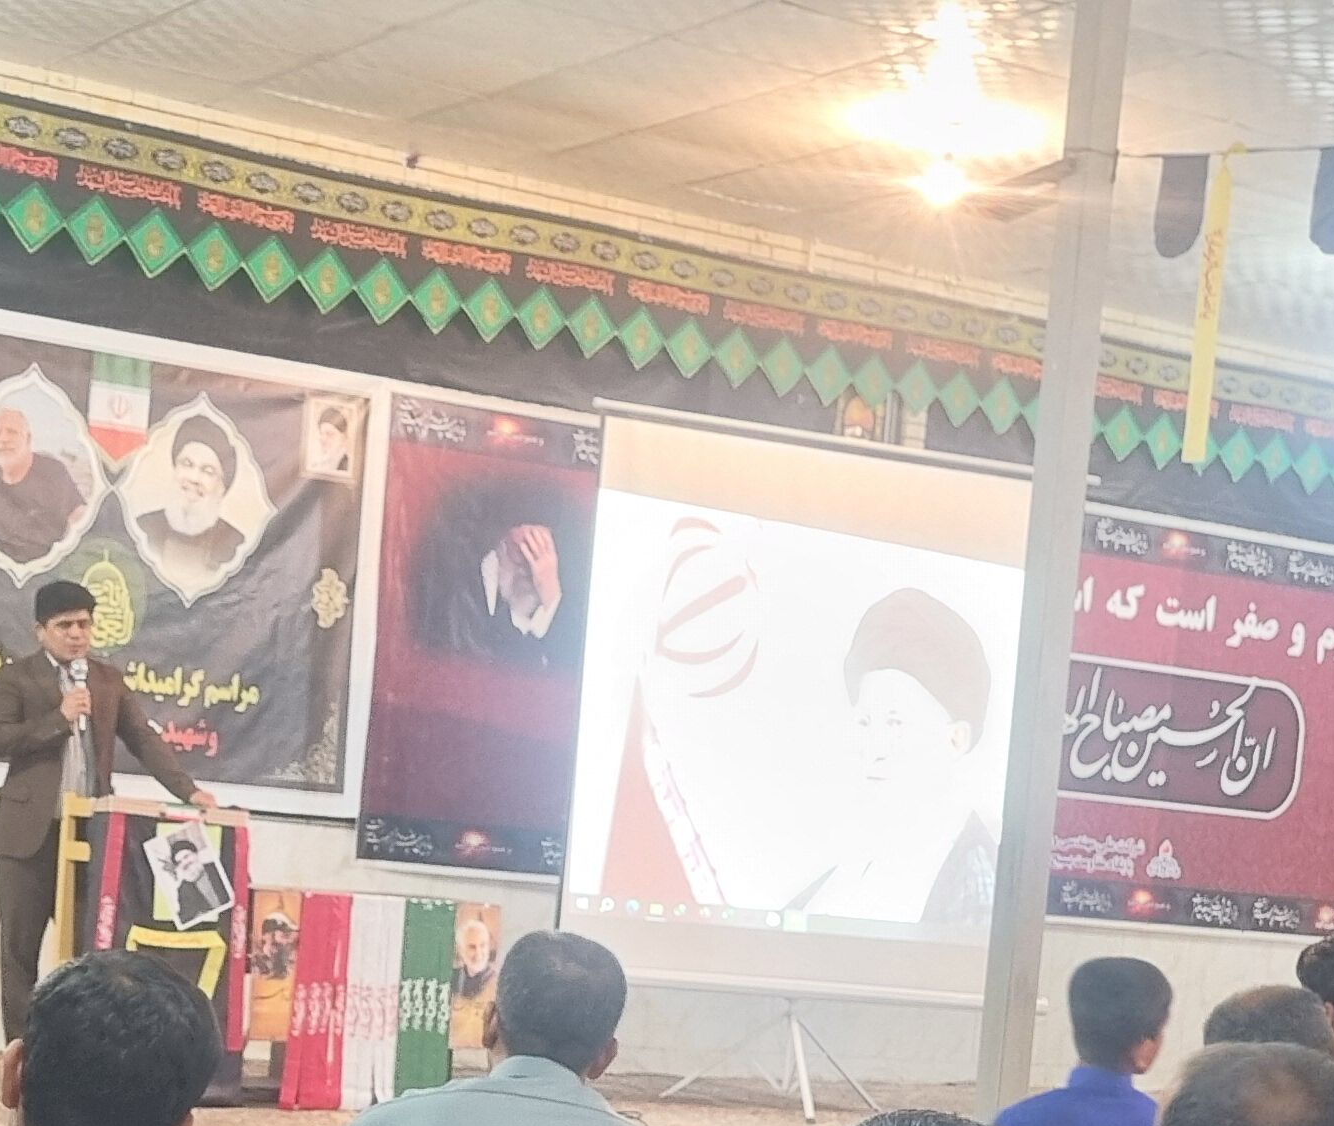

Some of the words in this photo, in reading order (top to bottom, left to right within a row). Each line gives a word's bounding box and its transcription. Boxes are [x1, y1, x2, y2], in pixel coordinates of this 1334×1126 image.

[1106, 583, 1146, 621] که
[1155, 594, 1217, 633] است
[1226, 601, 1280, 648] صفر
[1287, 621, 1306, 658] و
[203, 672, 261, 713] مراسم
